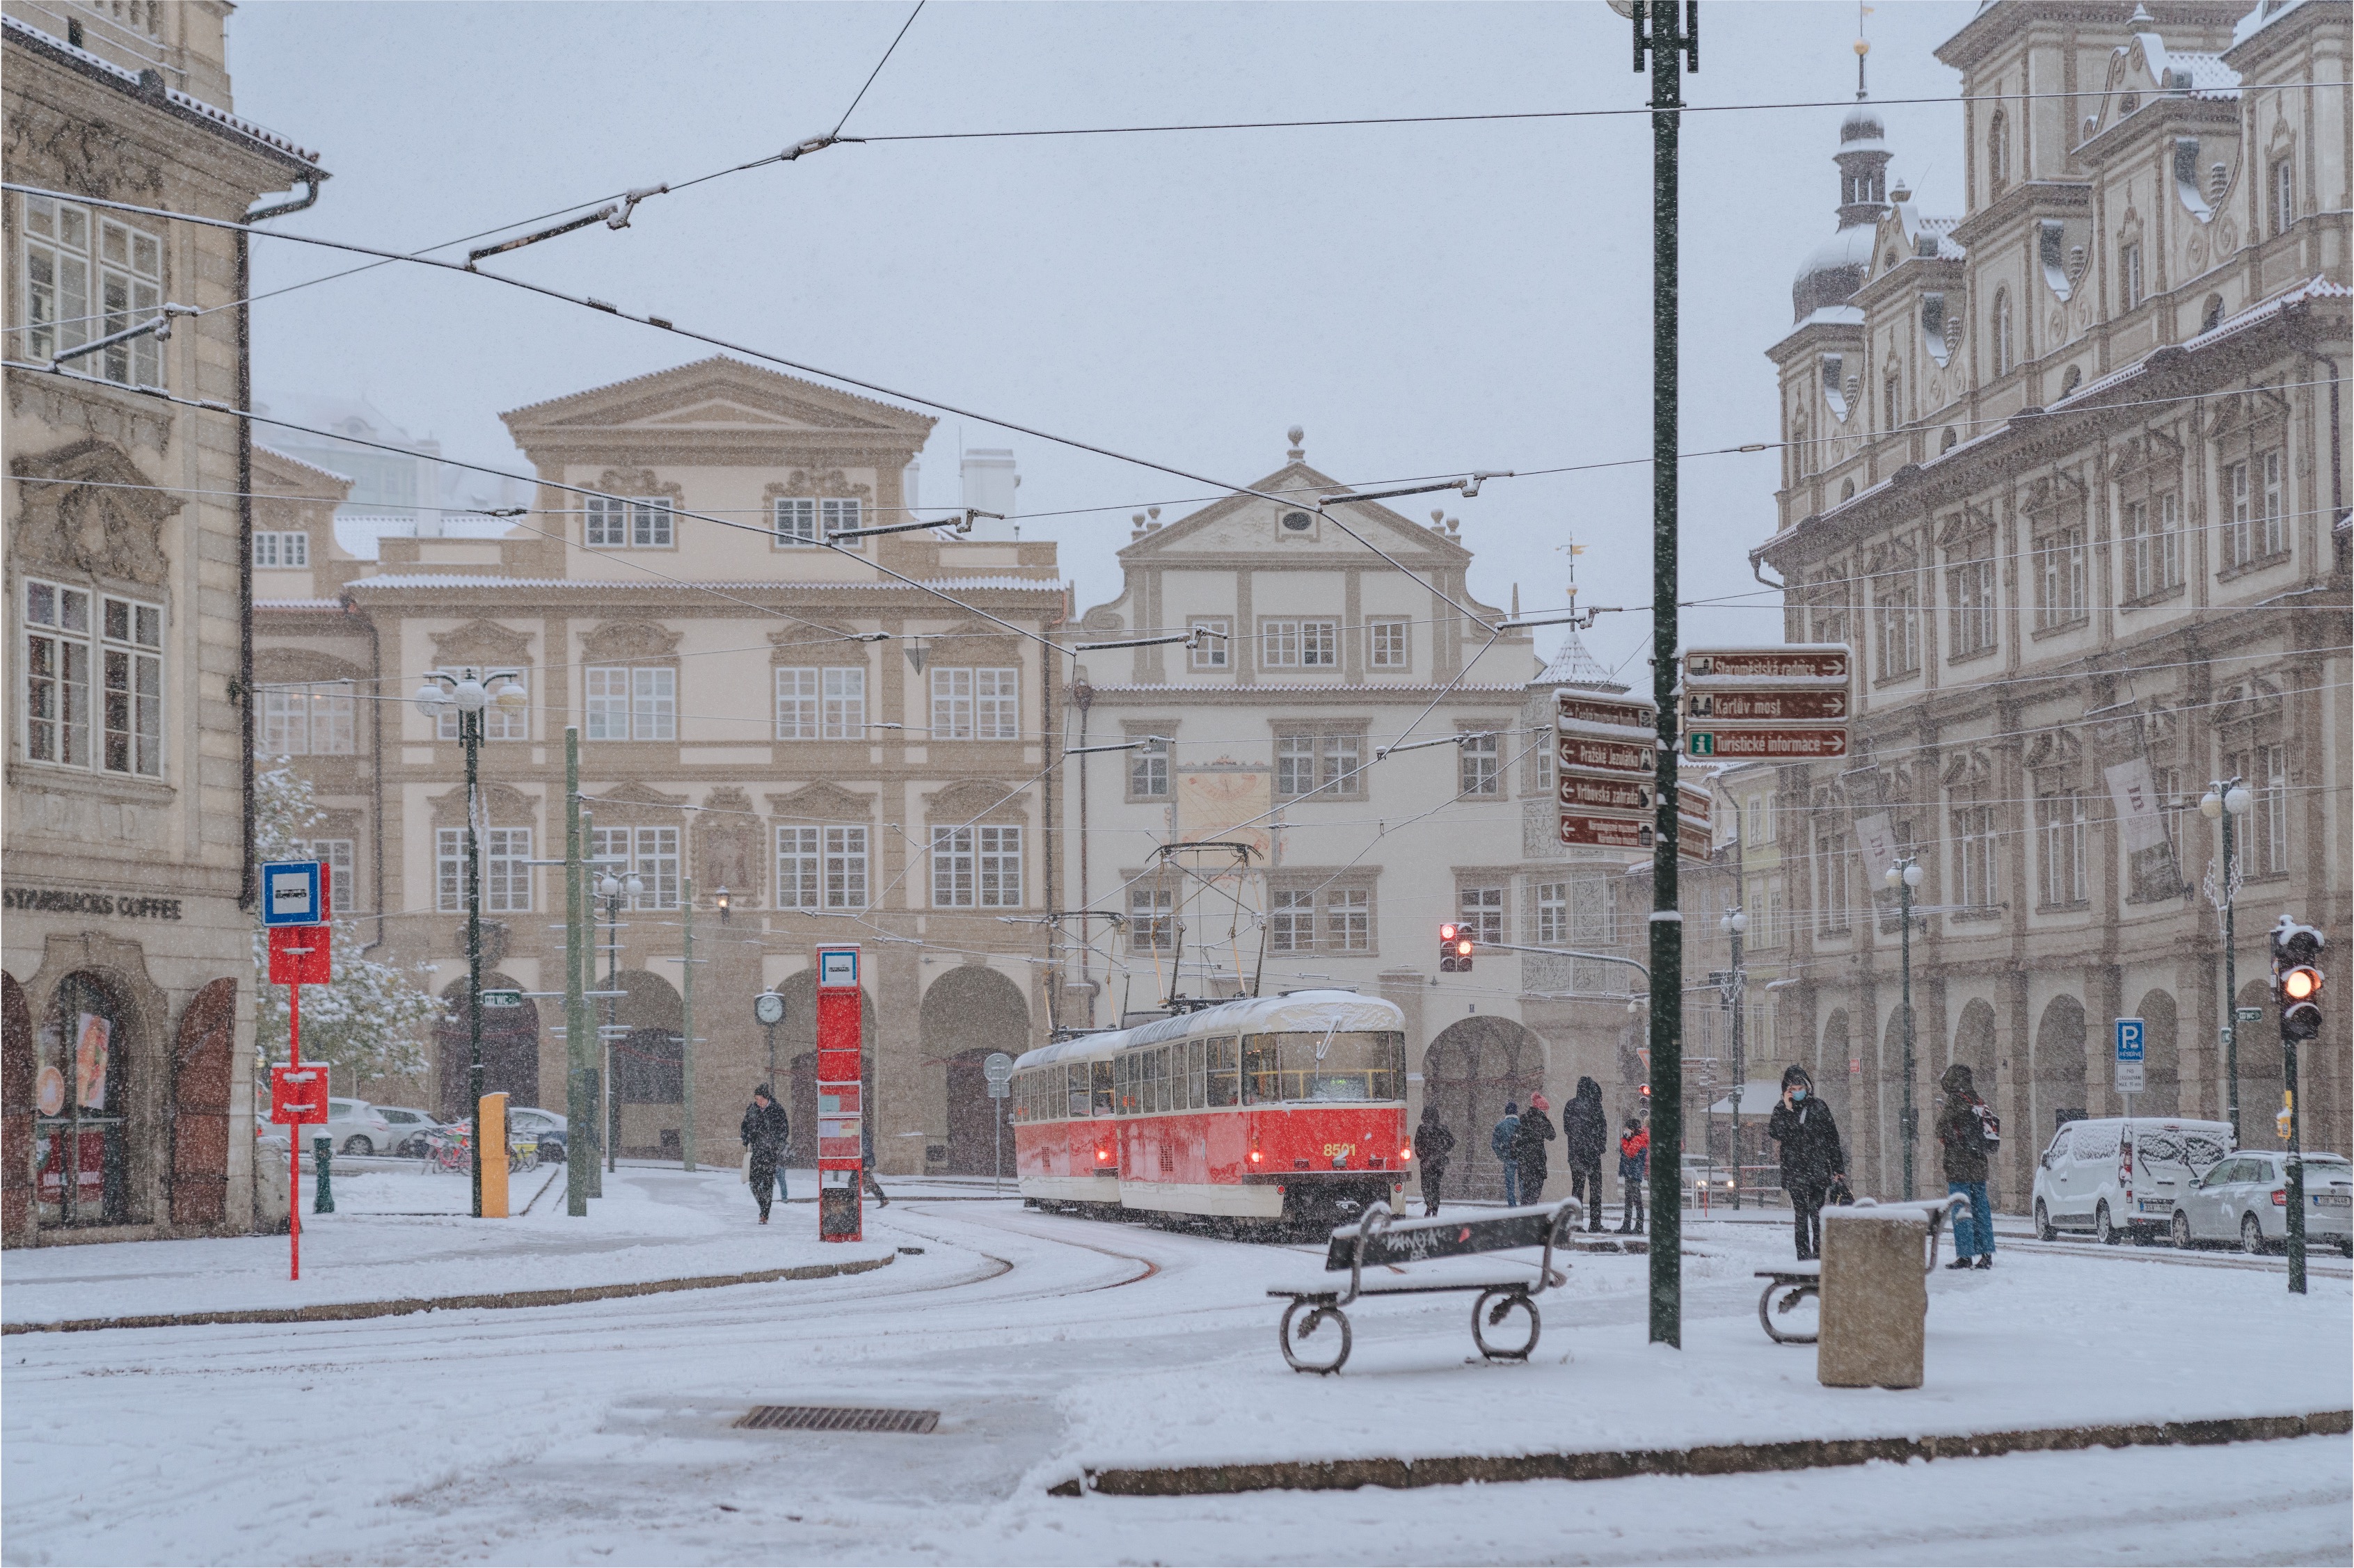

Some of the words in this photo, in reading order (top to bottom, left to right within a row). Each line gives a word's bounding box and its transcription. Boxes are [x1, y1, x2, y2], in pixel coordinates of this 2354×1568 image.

[1715, 659, 1779, 675] Staroměstská
[1781, 659, 1816, 675] radnice
[1715, 697, 1751, 715] Karlův
[1754, 698, 1781, 715] most
[1716, 735, 1765, 752] Turistické
[1767, 735, 1821, 752] informace
[1580, 745, 1607, 765] Pražské
[1576, 783, 1610, 803] Vrtbovská
[1612, 787, 1639, 805] zahrada
[3, 887, 114, 915] STARBUCKS
[117, 896, 182, 920] COFFEE
[495, 995, 509, 1005] WC
[2122, 1025, 2139, 1049] P
[1323, 1143, 1356, 1157] 8501
